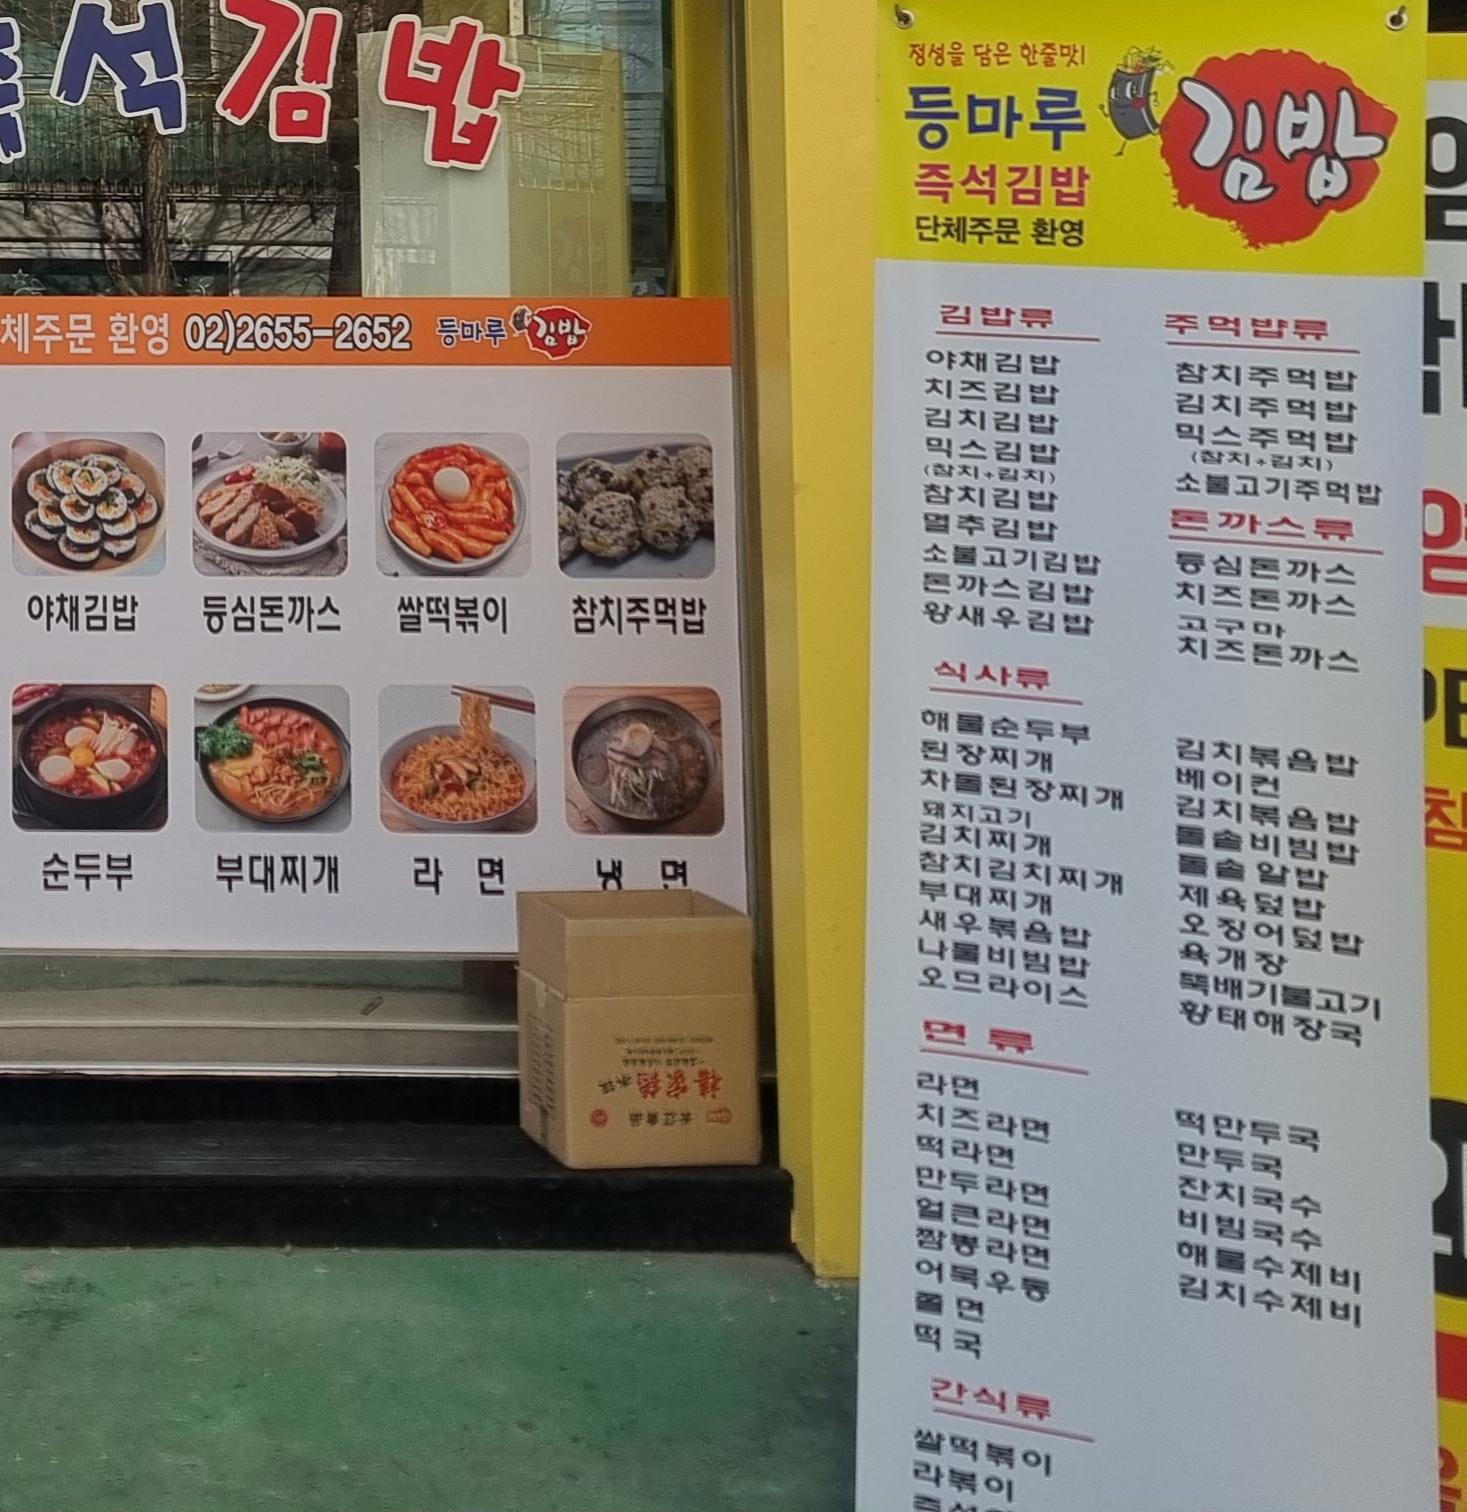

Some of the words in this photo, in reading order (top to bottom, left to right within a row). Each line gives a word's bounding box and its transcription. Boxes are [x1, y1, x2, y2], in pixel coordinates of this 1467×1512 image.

[909, 41, 967, 68] 정성을
[973, 43, 1012, 68] 담은
[905, 86, 1087, 151] 등마루
[1177, 76, 1387, 205] 김밥
[915, 164, 1090, 207] 즉석김밥
[916, 216, 1021, 245] 단체주문
[1031, 217, 1085, 247] 환영
[108, 310, 171, 355] 환영
[183, 309, 411, 355] 02)2655-2652
[435, 318, 507, 347] 등마루
[532, 315, 588, 349] 김밥
[940, 304, 1054, 328] 김밥류
[1165, 313, 1329, 341] 주먹밥류
[926, 348, 1060, 375] 야채김밥
[1175, 361, 1358, 393] 참치주먹밥
[925, 378, 1059, 405] 치즈김밥
[1175, 392, 1358, 423] 김치주먹밥
[924, 408, 1059, 435] 김치김밥
[1175, 422, 1359, 455] 믹스주먹밥
[926, 437, 1060, 464] 믹스김밥
[923, 484, 1058, 512] 참치김밥
[1175, 473, 1383, 507] 소불고기주먹밥
[1170, 509, 1354, 541] 돈까스류
[922, 543, 1101, 576] 소불고기김밥
[1175, 551, 1357, 586] 등심돈까스
[922, 573, 1093, 606] 돈까스김밥
[1175, 582, 1357, 617] 치즈돈까스
[26, 595, 139, 633] 야채김밥
[203, 595, 341, 635] 등심돈까스
[397, 595, 508, 635] 쌀떡볶이
[572, 596, 707, 636] 참치주먹밥
[922, 602, 1093, 636] 왕새우김밥
[1177, 614, 1286, 639] 고구마
[1177, 636, 1359, 673] 치즈돈까스
[934, 660, 1050, 690] 식사류
[920, 709, 1091, 745] 해물순두부
[920, 740, 1053, 772] 된장찌개
[1175, 737, 1358, 777] 김치볶음밥
[920, 769, 1124, 810] 차돌된장찌개
[1175, 766, 1280, 798] 베이컨
[922, 800, 1032, 829] 돼지고기
[1175, 795, 1359, 835] 김치볶음밥
[919, 824, 1051, 857] 김치찌개
[42, 853, 134, 890] 순두부
[215, 854, 340, 893] 부대찌개
[919, 851, 1124, 894] 참치김치찌개
[919, 881, 1052, 915] 부대찌개
[1177, 883, 1326, 921] 제육덮밥
[919, 910, 1091, 949] 새우볶음밥
[1179, 913, 1364, 956] 오징어덮밥
[918, 939, 1090, 978] 나물비빔밥
[1180, 945, 1287, 976] 육개장
[918, 968, 1090, 1009] 오므라이스
[1180, 1001, 1363, 1047] 황태해장국
[916, 1071, 979, 1100] 라면
[916, 1102, 1050, 1143] 치즈라면
[1175, 1107, 1321, 1151] 떡만두국
[916, 1134, 1015, 1168] 떡라면
[1176, 1141, 1283, 1180] 만두국
[915, 1164, 1049, 1206] 만두라면
[1177, 1175, 1322, 1218] 잔치국수
[915, 1196, 1050, 1239] 얼큰라면
[1177, 1209, 1322, 1252] 비빔국수
[915, 1227, 1050, 1270] 짬뽕라면
[1176, 1239, 1361, 1294] 해물수제비
[915, 1259, 1050, 1303] 어묵우동
[1177, 1272, 1362, 1328] 김치수제비
[931, 1378, 1051, 1419] 간식류
[913, 1428, 1051, 1476] 쌀떡볶이
[913, 1461, 1013, 1502] 라볶이
